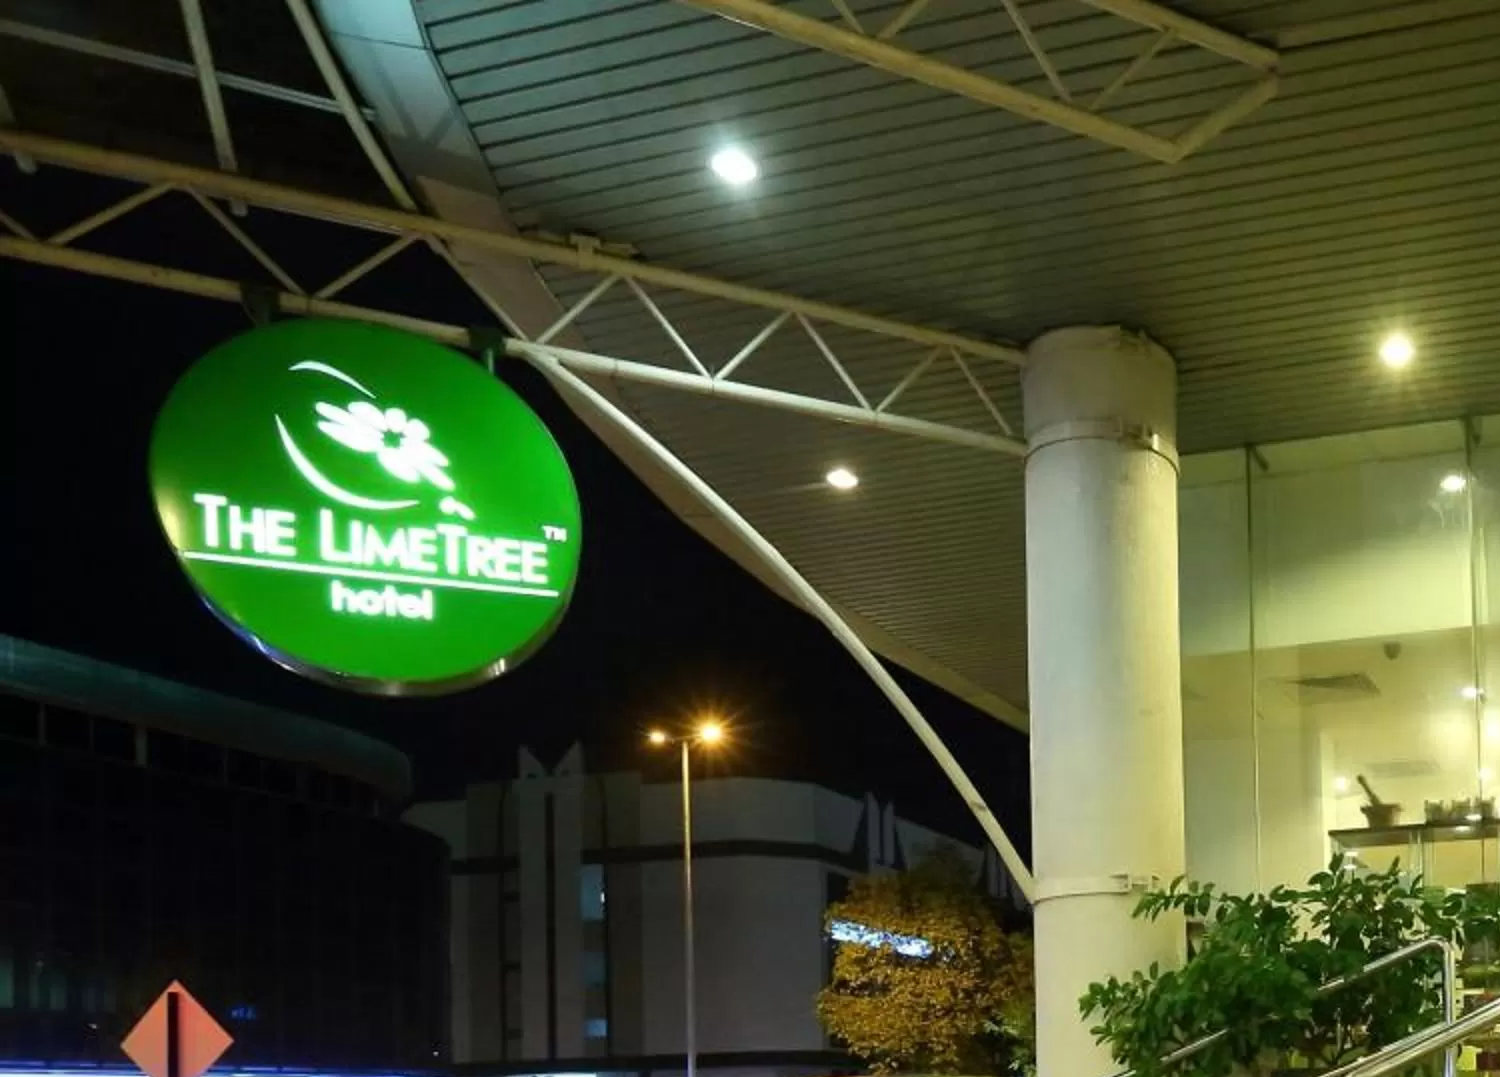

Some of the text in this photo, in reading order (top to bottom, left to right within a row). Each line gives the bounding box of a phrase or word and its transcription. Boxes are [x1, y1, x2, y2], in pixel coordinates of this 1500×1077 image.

[193, 492, 297, 557] THE
[319, 507, 549, 585] LIMETREE
[331, 579, 434, 621] hotel
